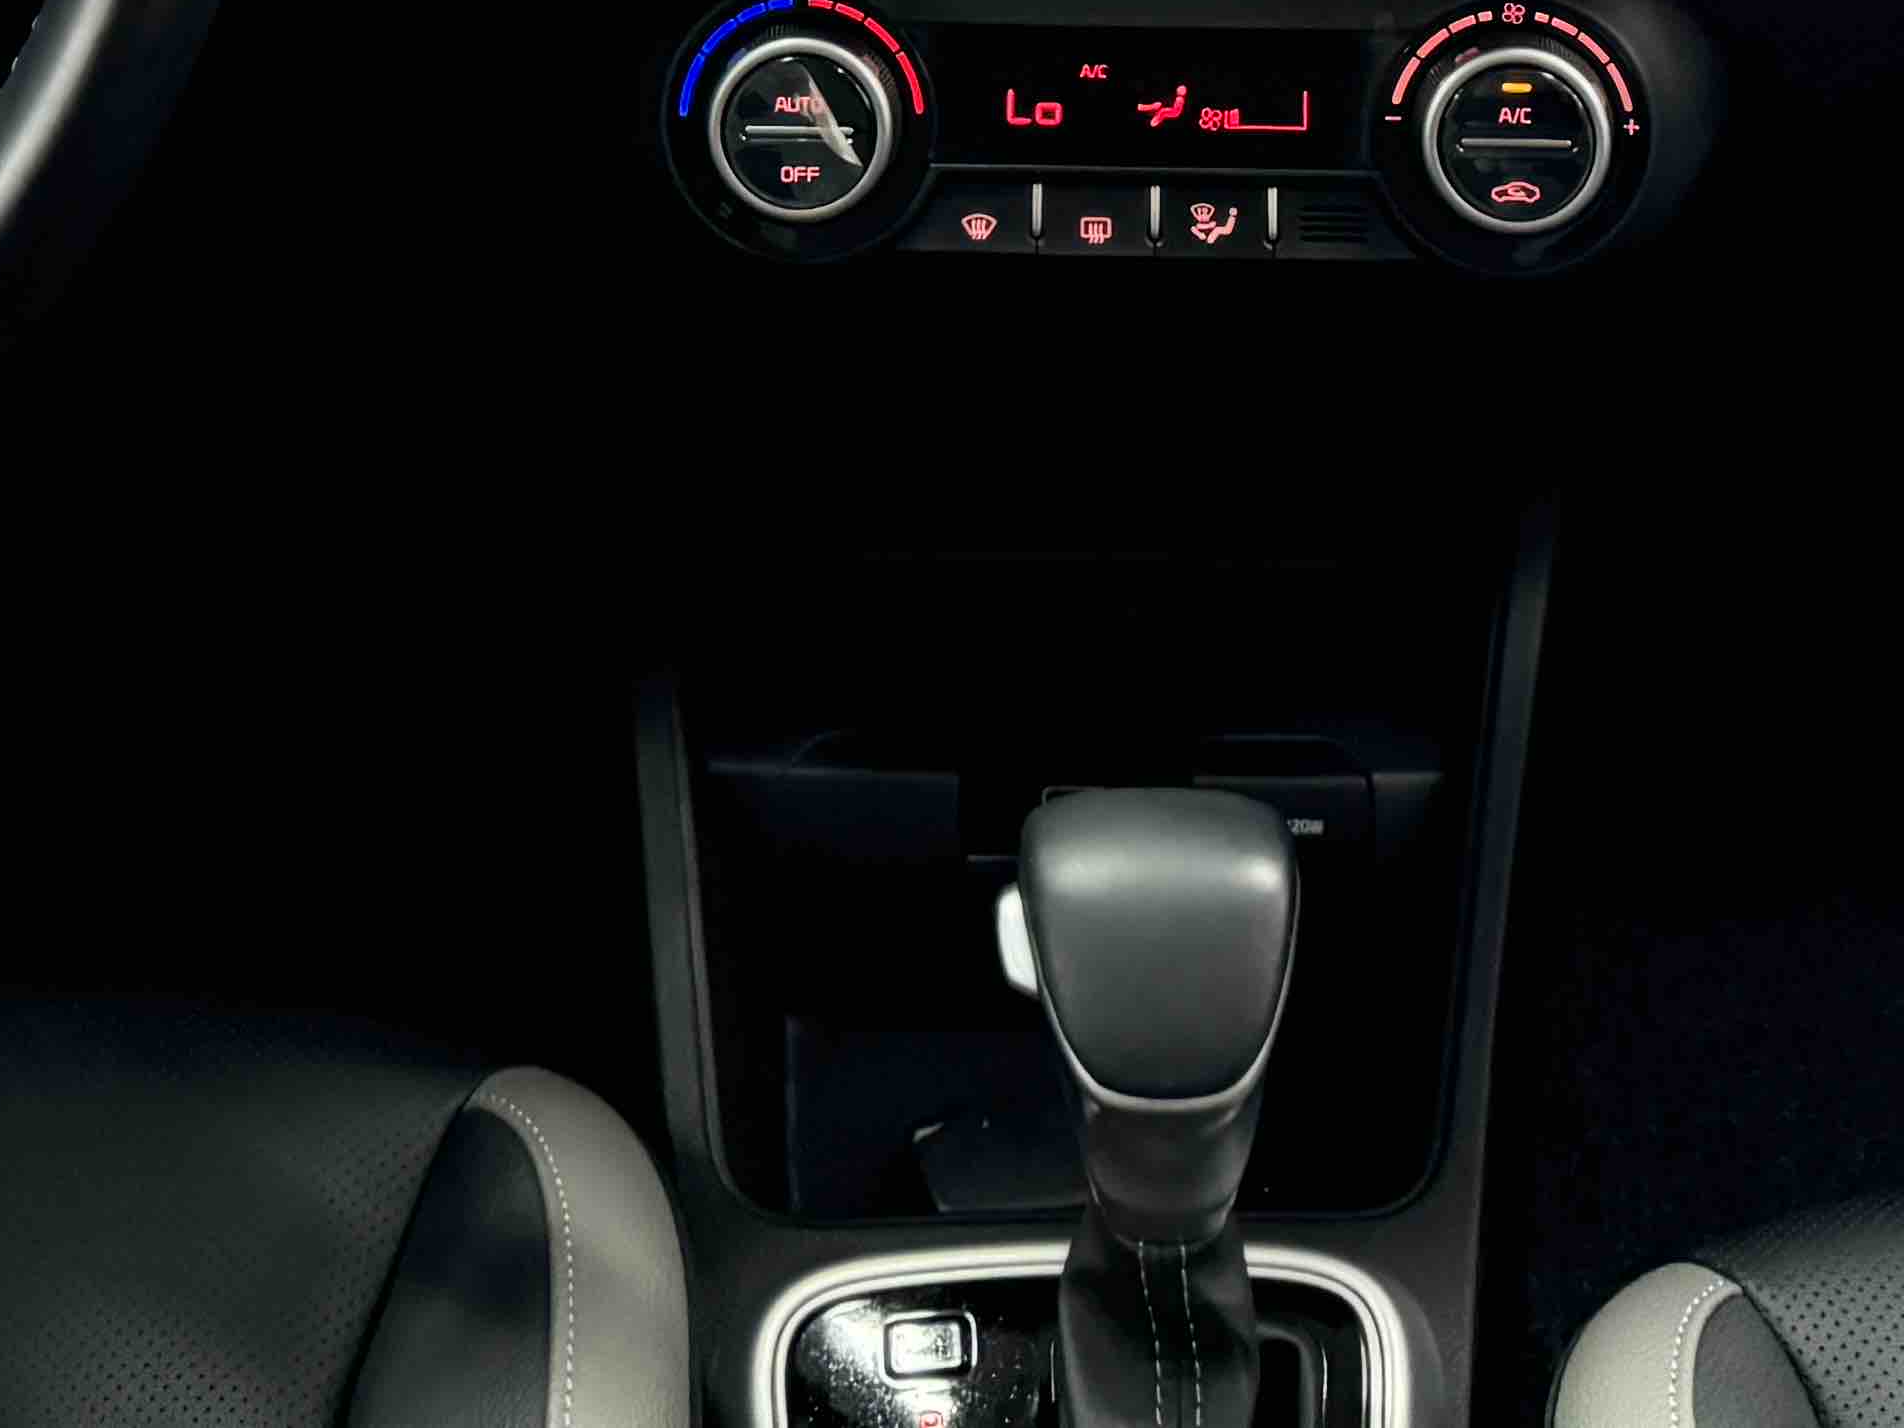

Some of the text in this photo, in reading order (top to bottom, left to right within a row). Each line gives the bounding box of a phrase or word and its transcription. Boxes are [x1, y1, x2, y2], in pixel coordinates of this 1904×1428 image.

[1078, 63, 1111, 80] A/C
[773, 95, 825, 114] AUTO
[1006, 88, 1063, 126] Lo
[1497, 106, 1533, 125] A/C
[779, 166, 821, 184] OFF
